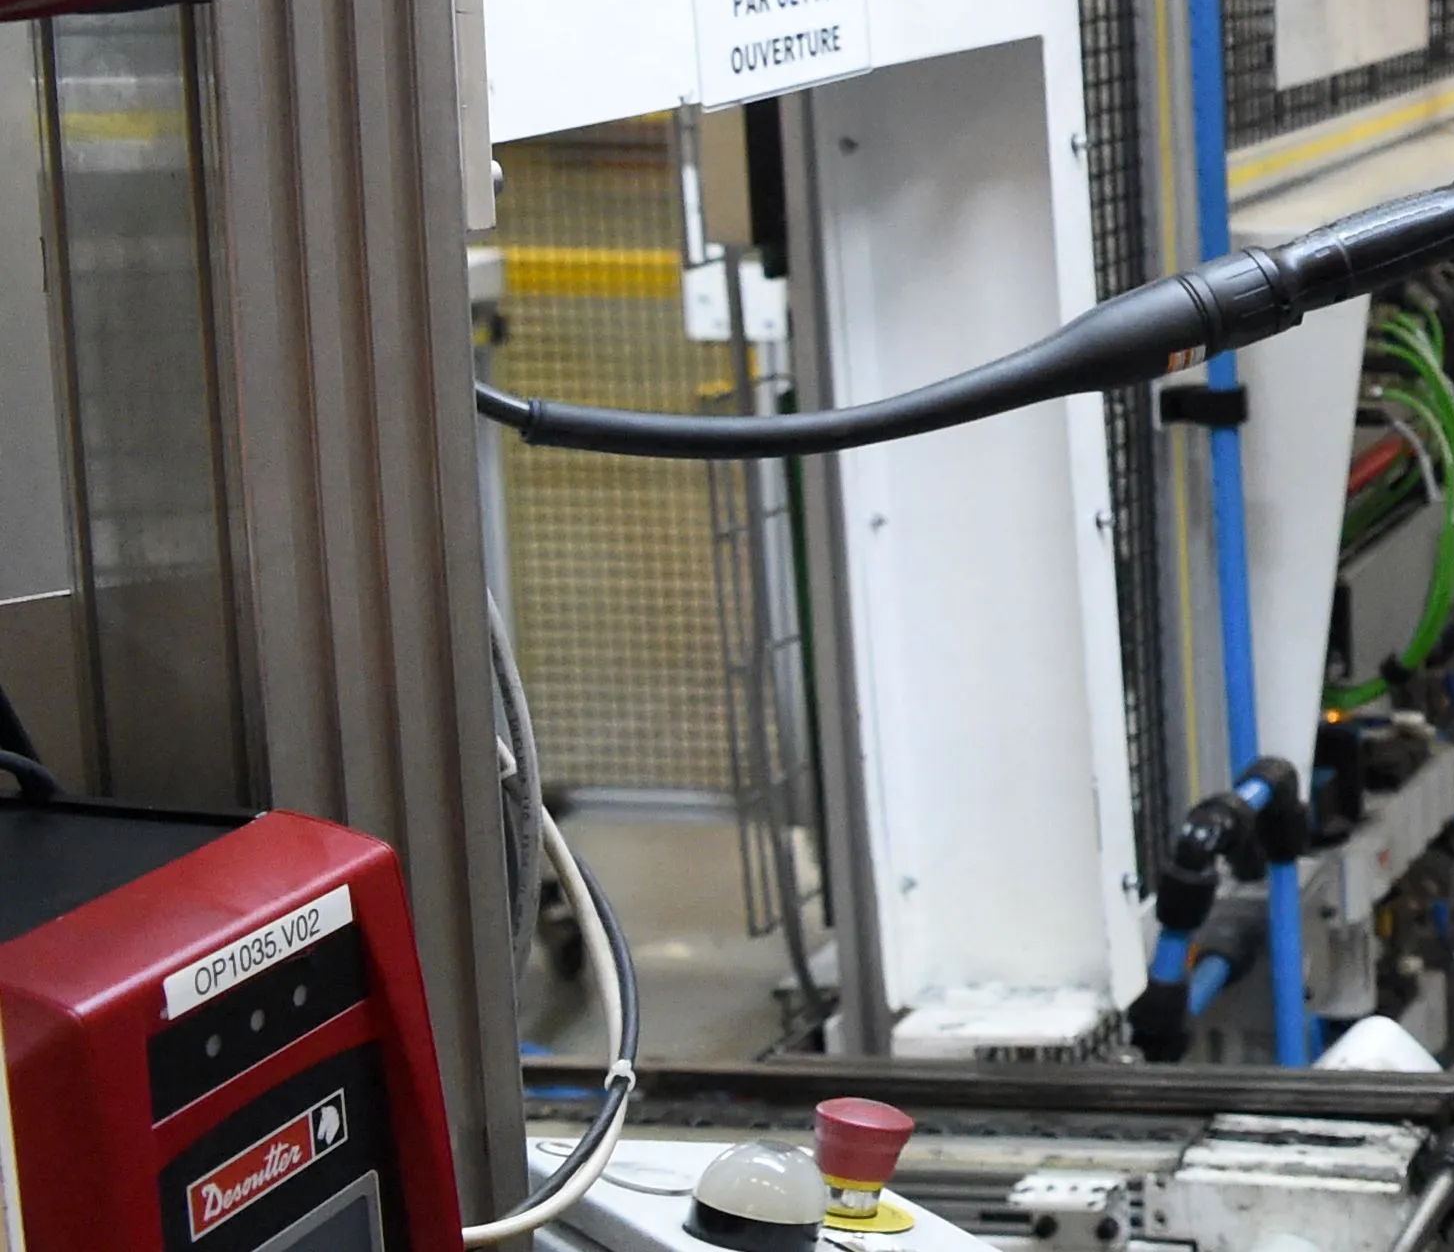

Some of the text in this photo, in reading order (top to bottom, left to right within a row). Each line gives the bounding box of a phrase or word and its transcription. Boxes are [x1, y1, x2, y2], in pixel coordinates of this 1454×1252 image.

[730, 25, 842, 75] OUVERTURE
[194, 908, 321, 996] OP1035.V02
[201, 1142, 302, 1222] Desoutter
